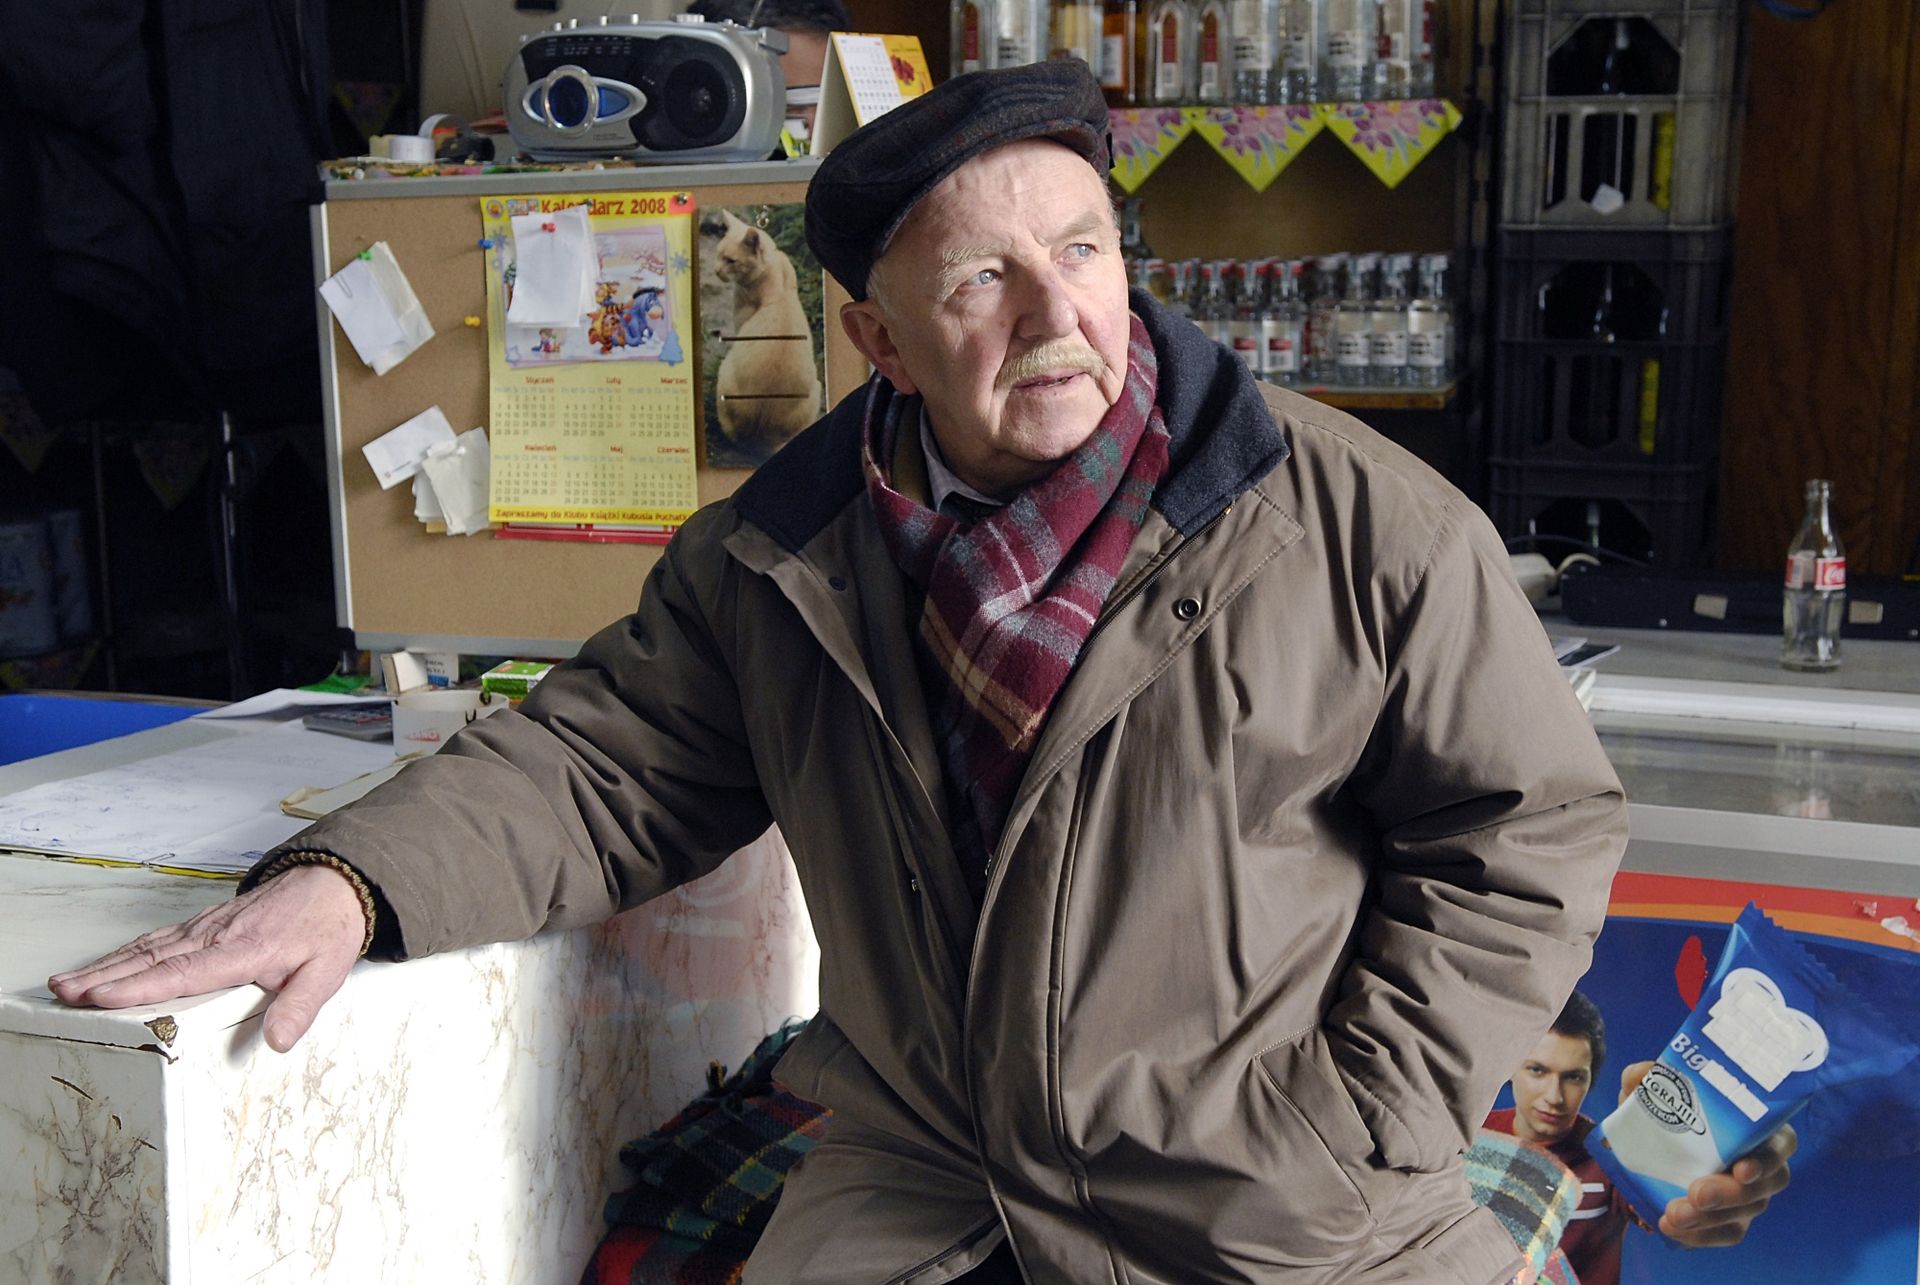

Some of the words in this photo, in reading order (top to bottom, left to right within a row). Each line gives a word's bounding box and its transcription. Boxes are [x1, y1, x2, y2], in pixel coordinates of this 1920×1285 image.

[542, 199, 624, 215] Kaldarz
[630, 199, 666, 214] 2008
[496, 510, 548, 520] Zapraszamy
[551, 511, 562, 519] do
[655, 512, 688, 521] Puchatk
[1670, 1032, 1709, 1072] Big
